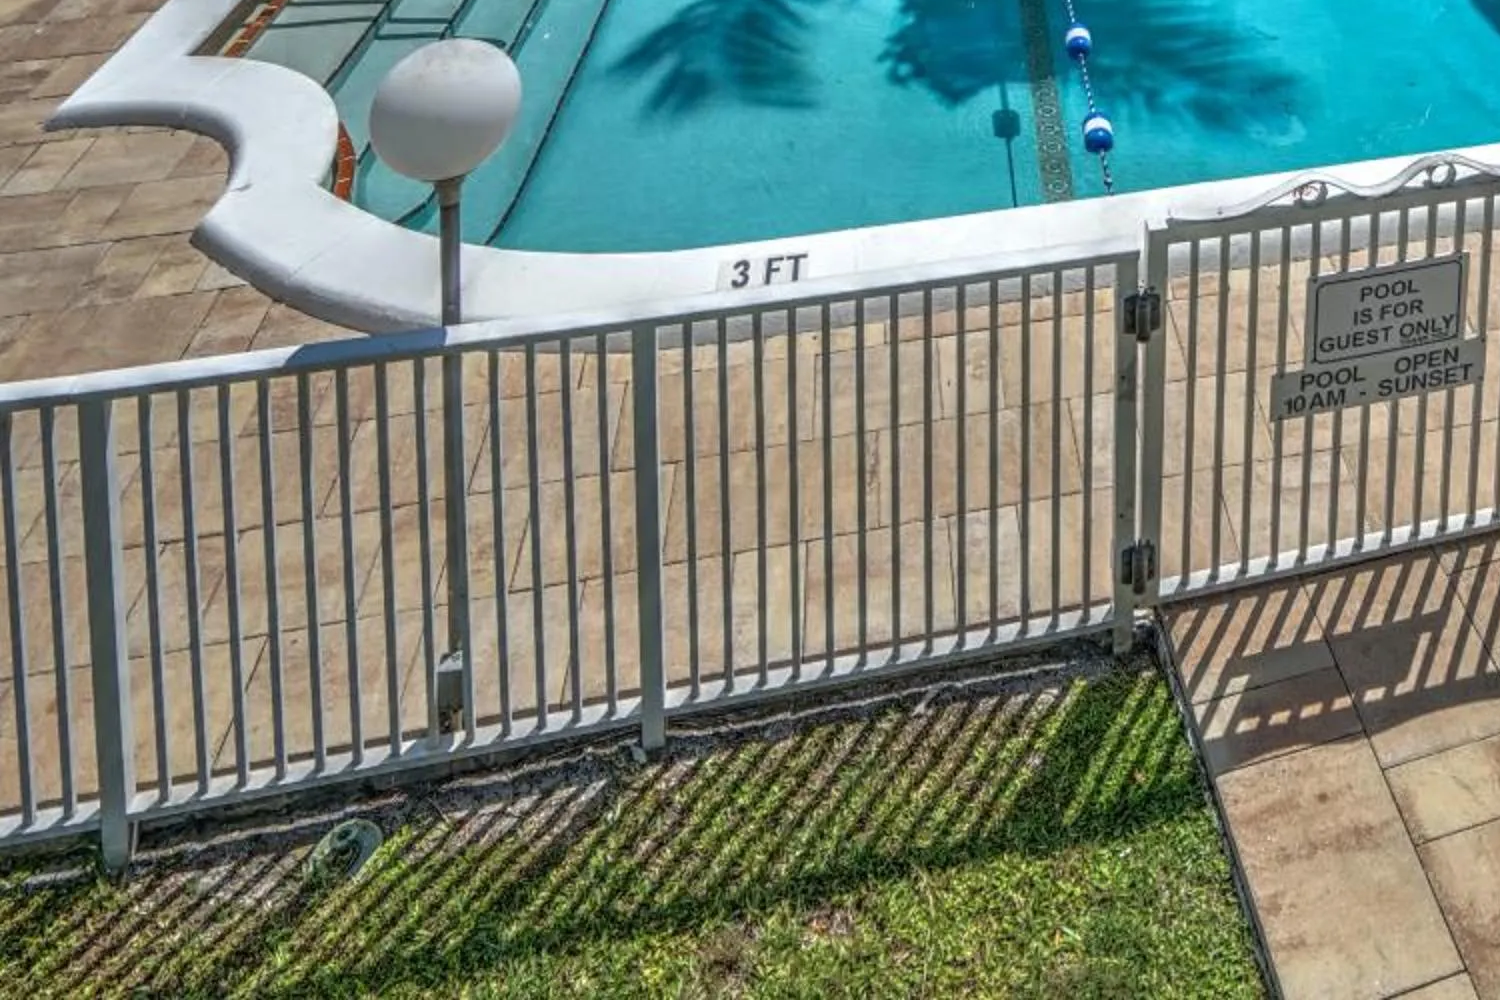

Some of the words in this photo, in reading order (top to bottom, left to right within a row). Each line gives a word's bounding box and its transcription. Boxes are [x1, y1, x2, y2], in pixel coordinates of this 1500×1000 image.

[731, 259, 751, 288] 3
[764, 253, 808, 285] FT
[1360, 279, 1420, 302] POOL
[1353, 308, 1373, 326] IS
[1379, 299, 1424, 321] FOR
[1319, 325, 1394, 353] GUEST
[1399, 314, 1455, 339] ONLY
[1300, 365, 1366, 391] POOL
[1394, 347, 1459, 374] OPEN
[1283, 388, 1346, 415] 10AM
[1378, 363, 1473, 398] SUNSET
